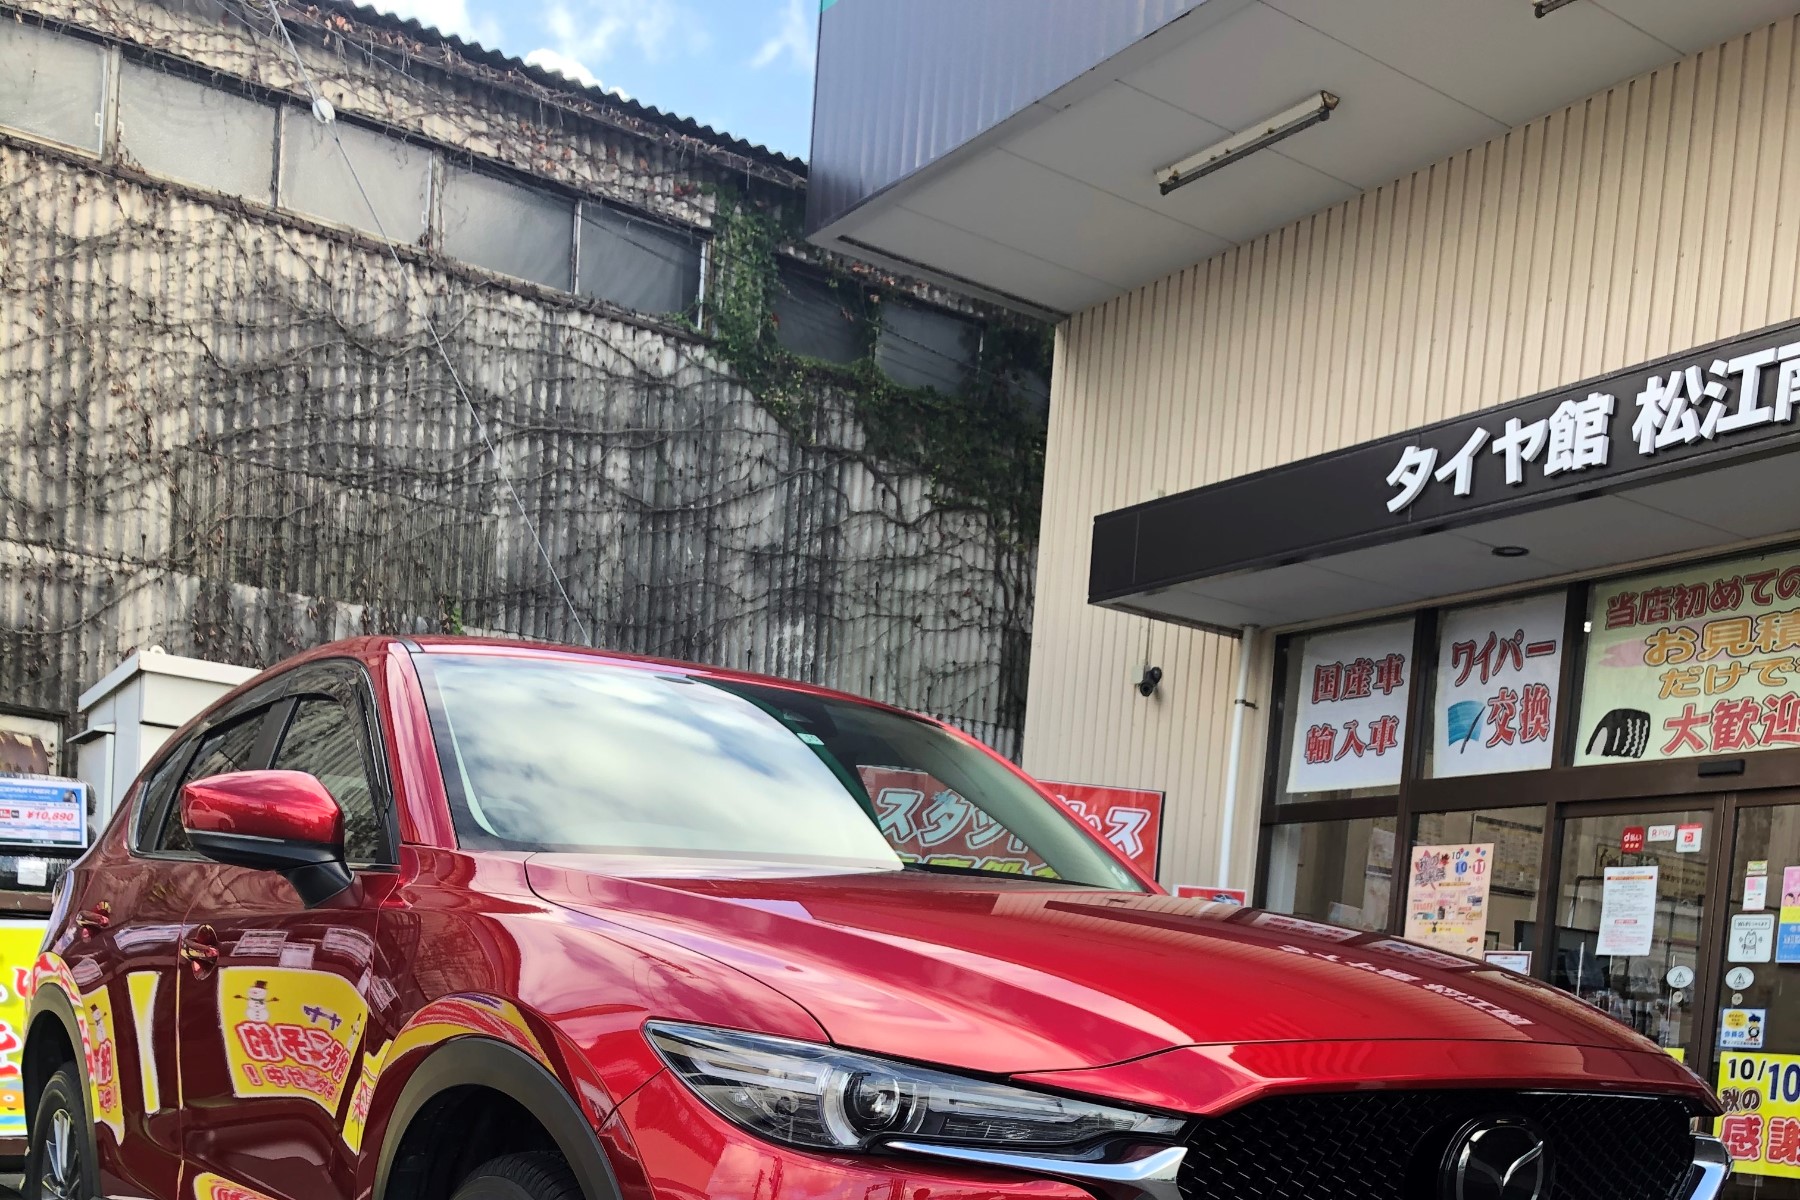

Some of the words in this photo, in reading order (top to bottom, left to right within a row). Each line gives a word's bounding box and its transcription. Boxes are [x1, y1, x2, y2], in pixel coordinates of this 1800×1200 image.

[1386, 392, 1615, 513] タイヤ館
[1605, 565, 1800, 629] 当店初めての
[1452, 629, 1557, 686] ワイパー
[1643, 608, 1800, 666] お見積
[1311, 653, 1404, 704] 国産車
[1658, 656, 1800, 699] だけで
[1305, 715, 1400, 764] 輸入車
[1486, 683, 1551, 748] 交換
[1660, 692, 1800, 755] 大歓迎
[27, 811, 74, 821] ¥10,890
[1720, 1088, 1762, 1114] 秋の
